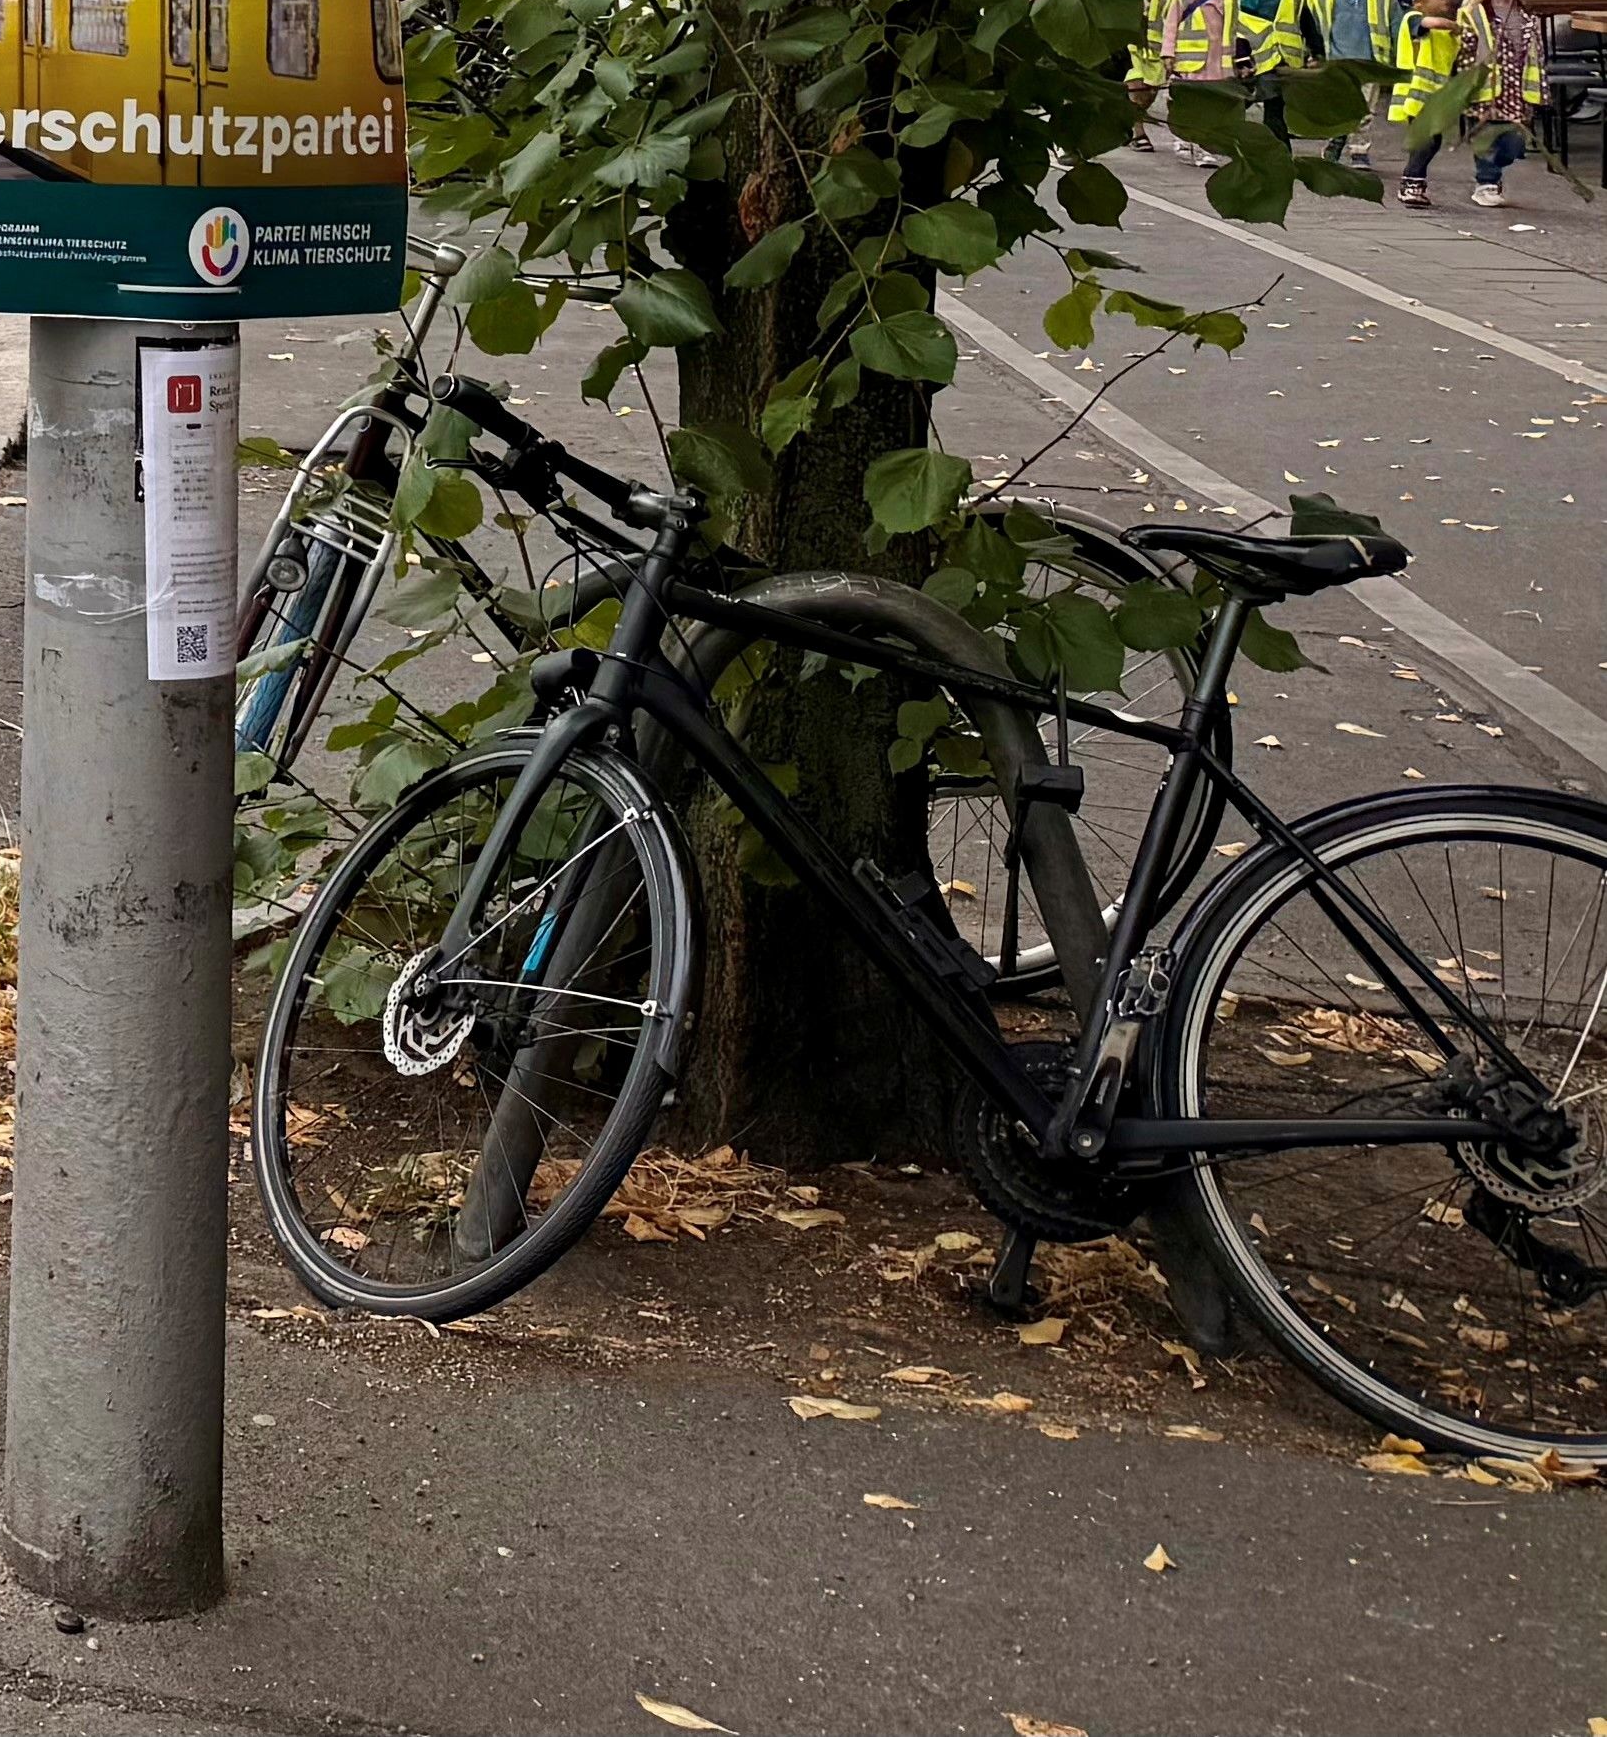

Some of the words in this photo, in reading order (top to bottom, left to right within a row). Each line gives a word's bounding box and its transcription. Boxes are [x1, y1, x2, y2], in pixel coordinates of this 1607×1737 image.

[254, 225, 308, 244] PARTEI
[310, 224, 372, 242] MENSCH
[253, 248, 300, 266] KLIMA
[303, 245, 392, 265] TIERSCHUTZ
